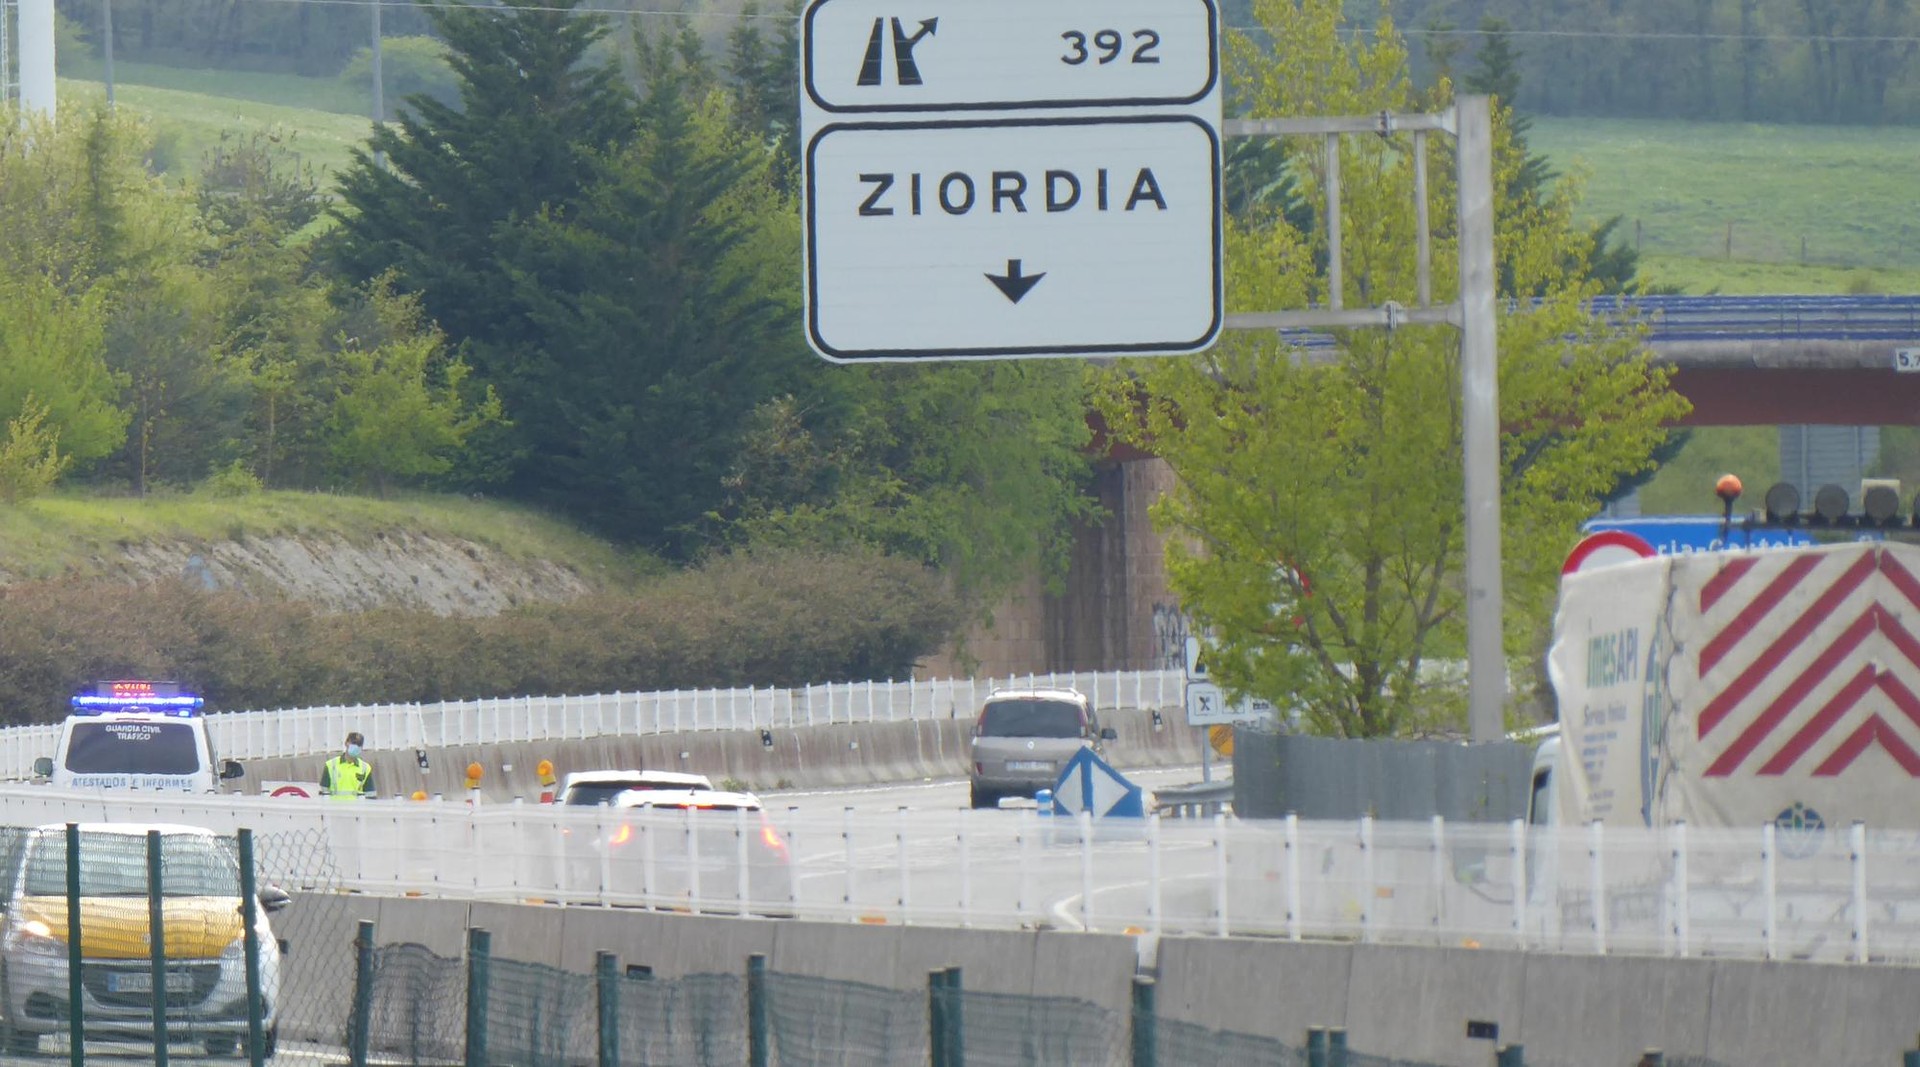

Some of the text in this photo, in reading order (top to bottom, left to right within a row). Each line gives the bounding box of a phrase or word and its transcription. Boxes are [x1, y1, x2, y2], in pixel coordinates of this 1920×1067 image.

[1061, 29, 1160, 65] 392
[858, 167, 1168, 216] ZIORDIA
[105, 724, 161, 734] GUARDIA CIVIL
[72, 777, 126, 789] ATESTADOS
[142, 779, 193, 789] INFORMES
